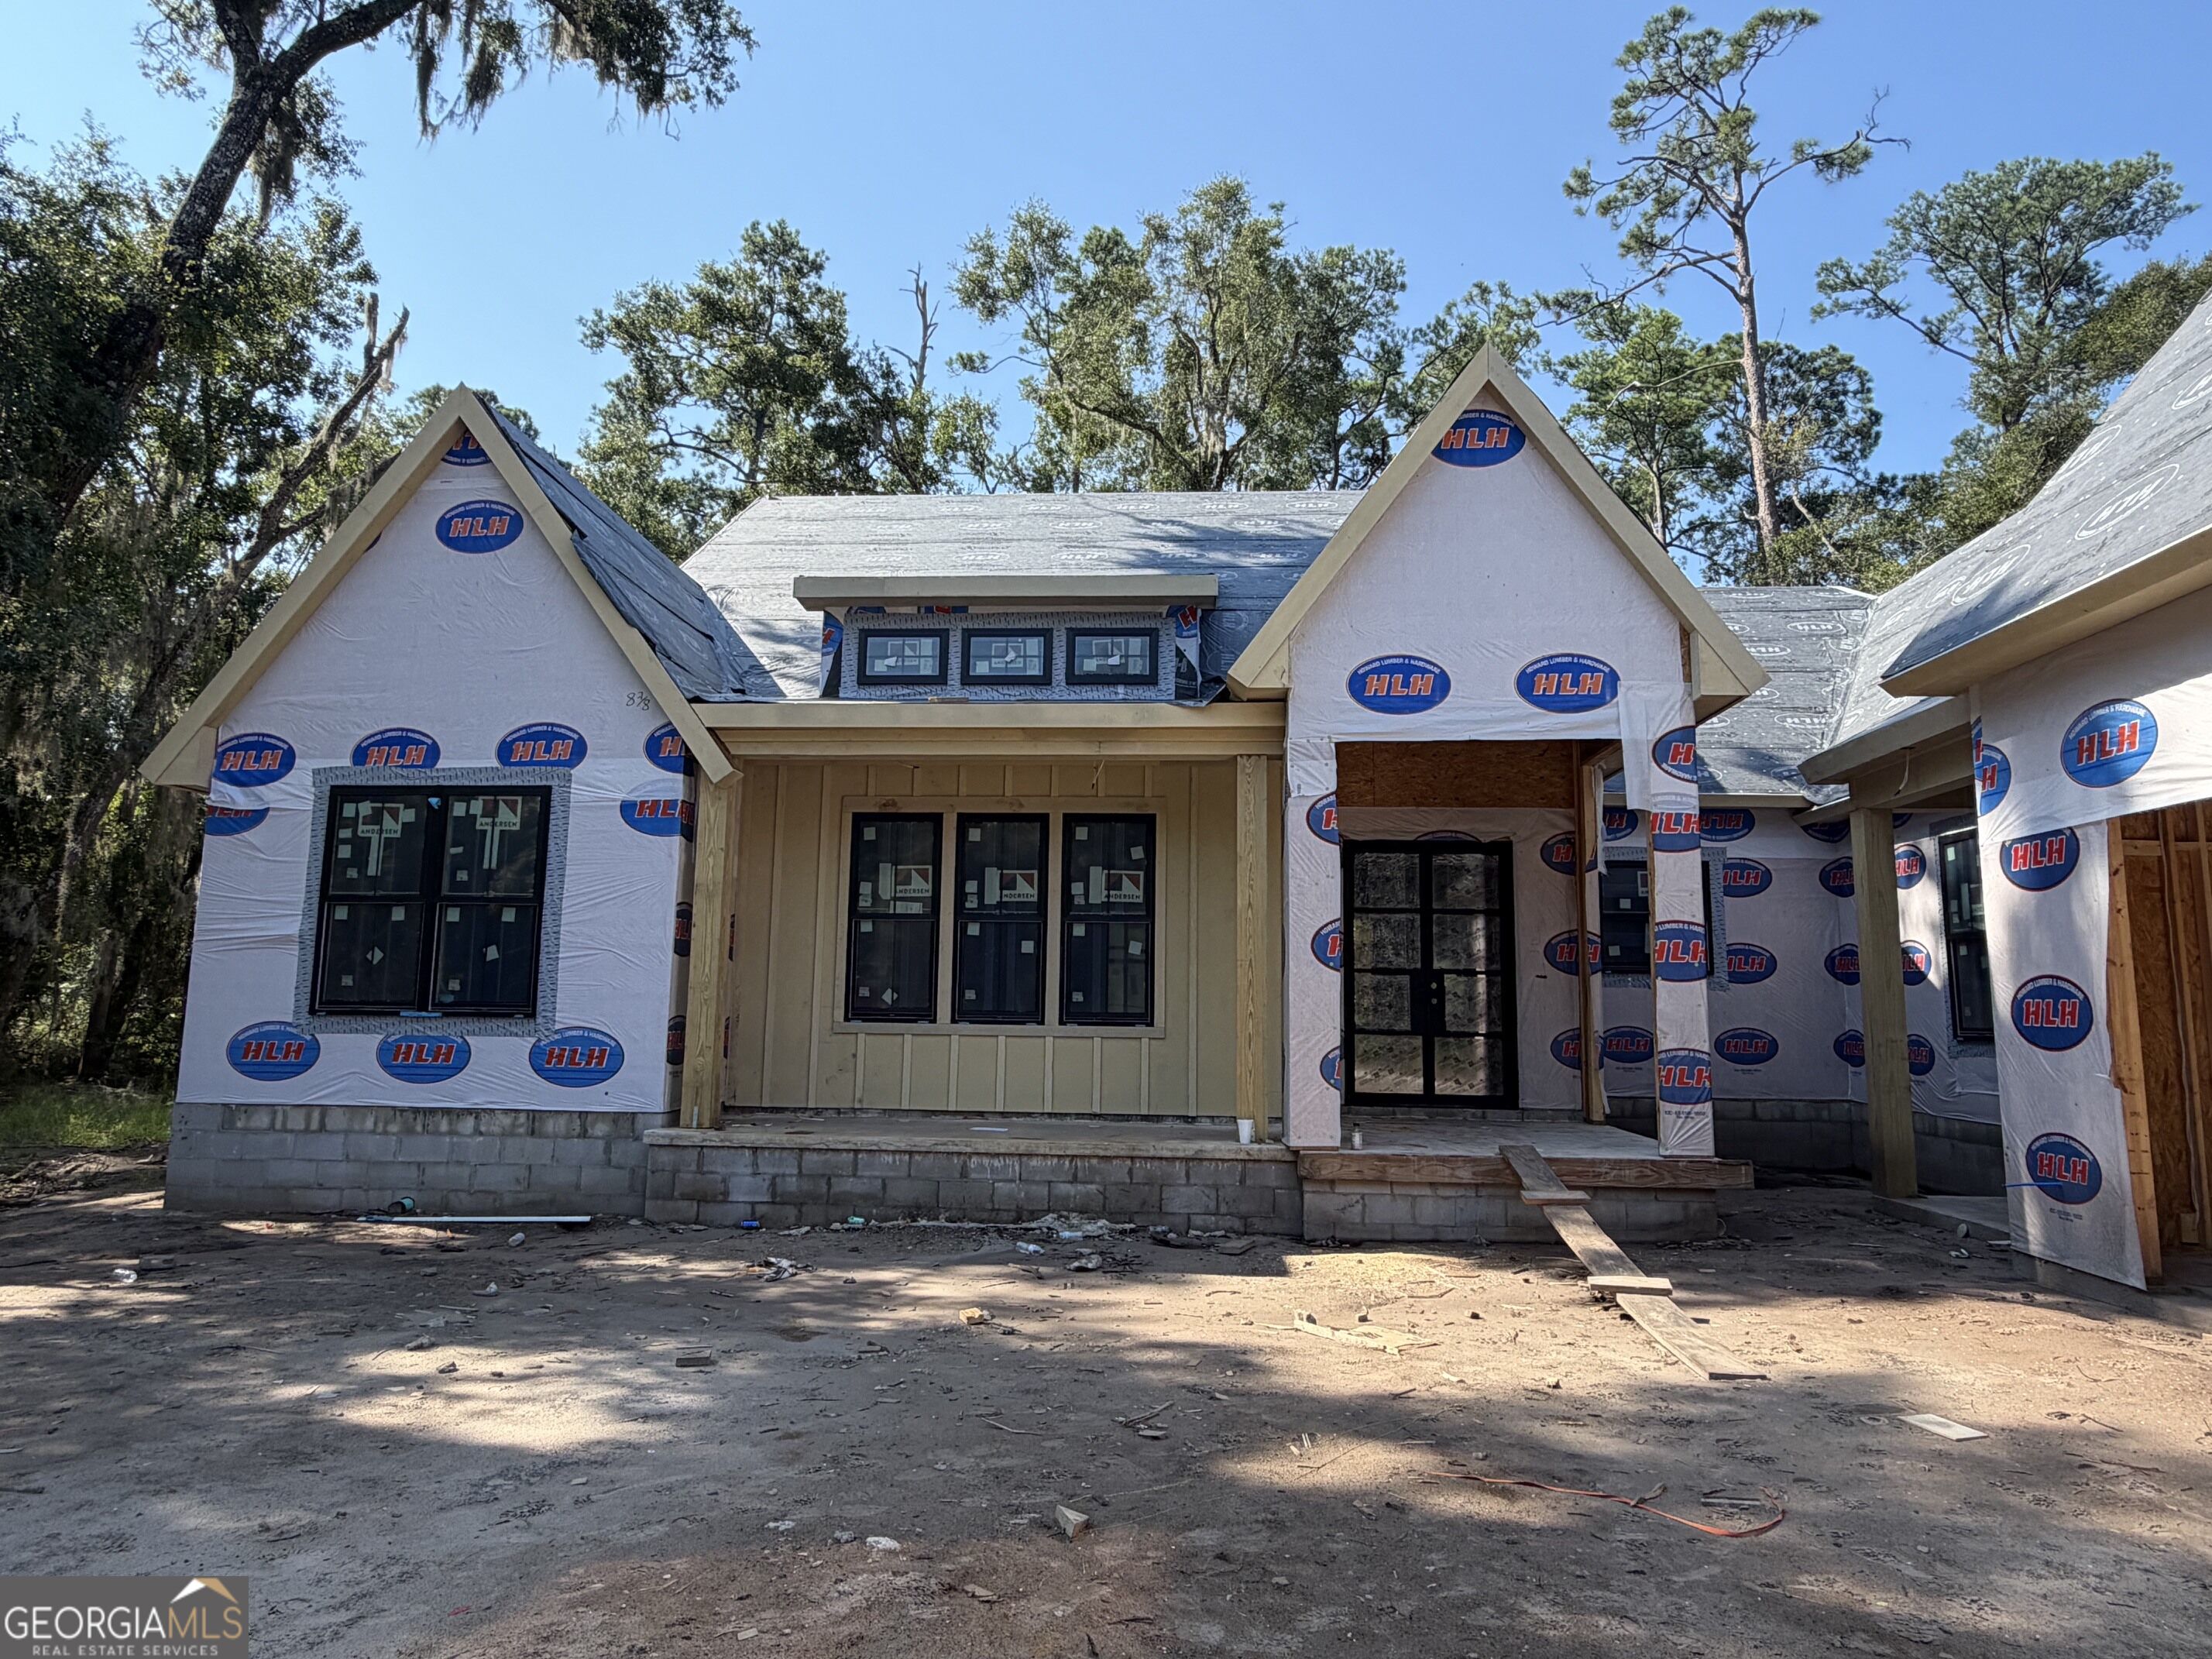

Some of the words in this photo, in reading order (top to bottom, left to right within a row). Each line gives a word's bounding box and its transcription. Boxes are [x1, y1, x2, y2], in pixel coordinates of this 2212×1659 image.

[1441, 427, 1510, 449] HLH
[449, 517, 510, 537] HLH
[1364, 674, 1434, 696] HLH
[1533, 672, 1604, 695] HLH
[510, 740, 573, 761] HLH
[2076, 720, 2140, 766] HLH
[220, 750, 283, 771] HLH
[366, 745, 428, 767] HLH
[2011, 835, 2066, 872] HLH
[1557, 944, 1601, 963] HH
[2022, 999, 2080, 1028] HLH
[241, 1040, 306, 1062] HLH
[391, 1043, 457, 1064] HLH
[1606, 1038, 1650, 1052] HLH
[1724, 1039, 1768, 1053] HLH
[544, 1046, 610, 1068] HLH
[2037, 1152, 2090, 1186] HLH
